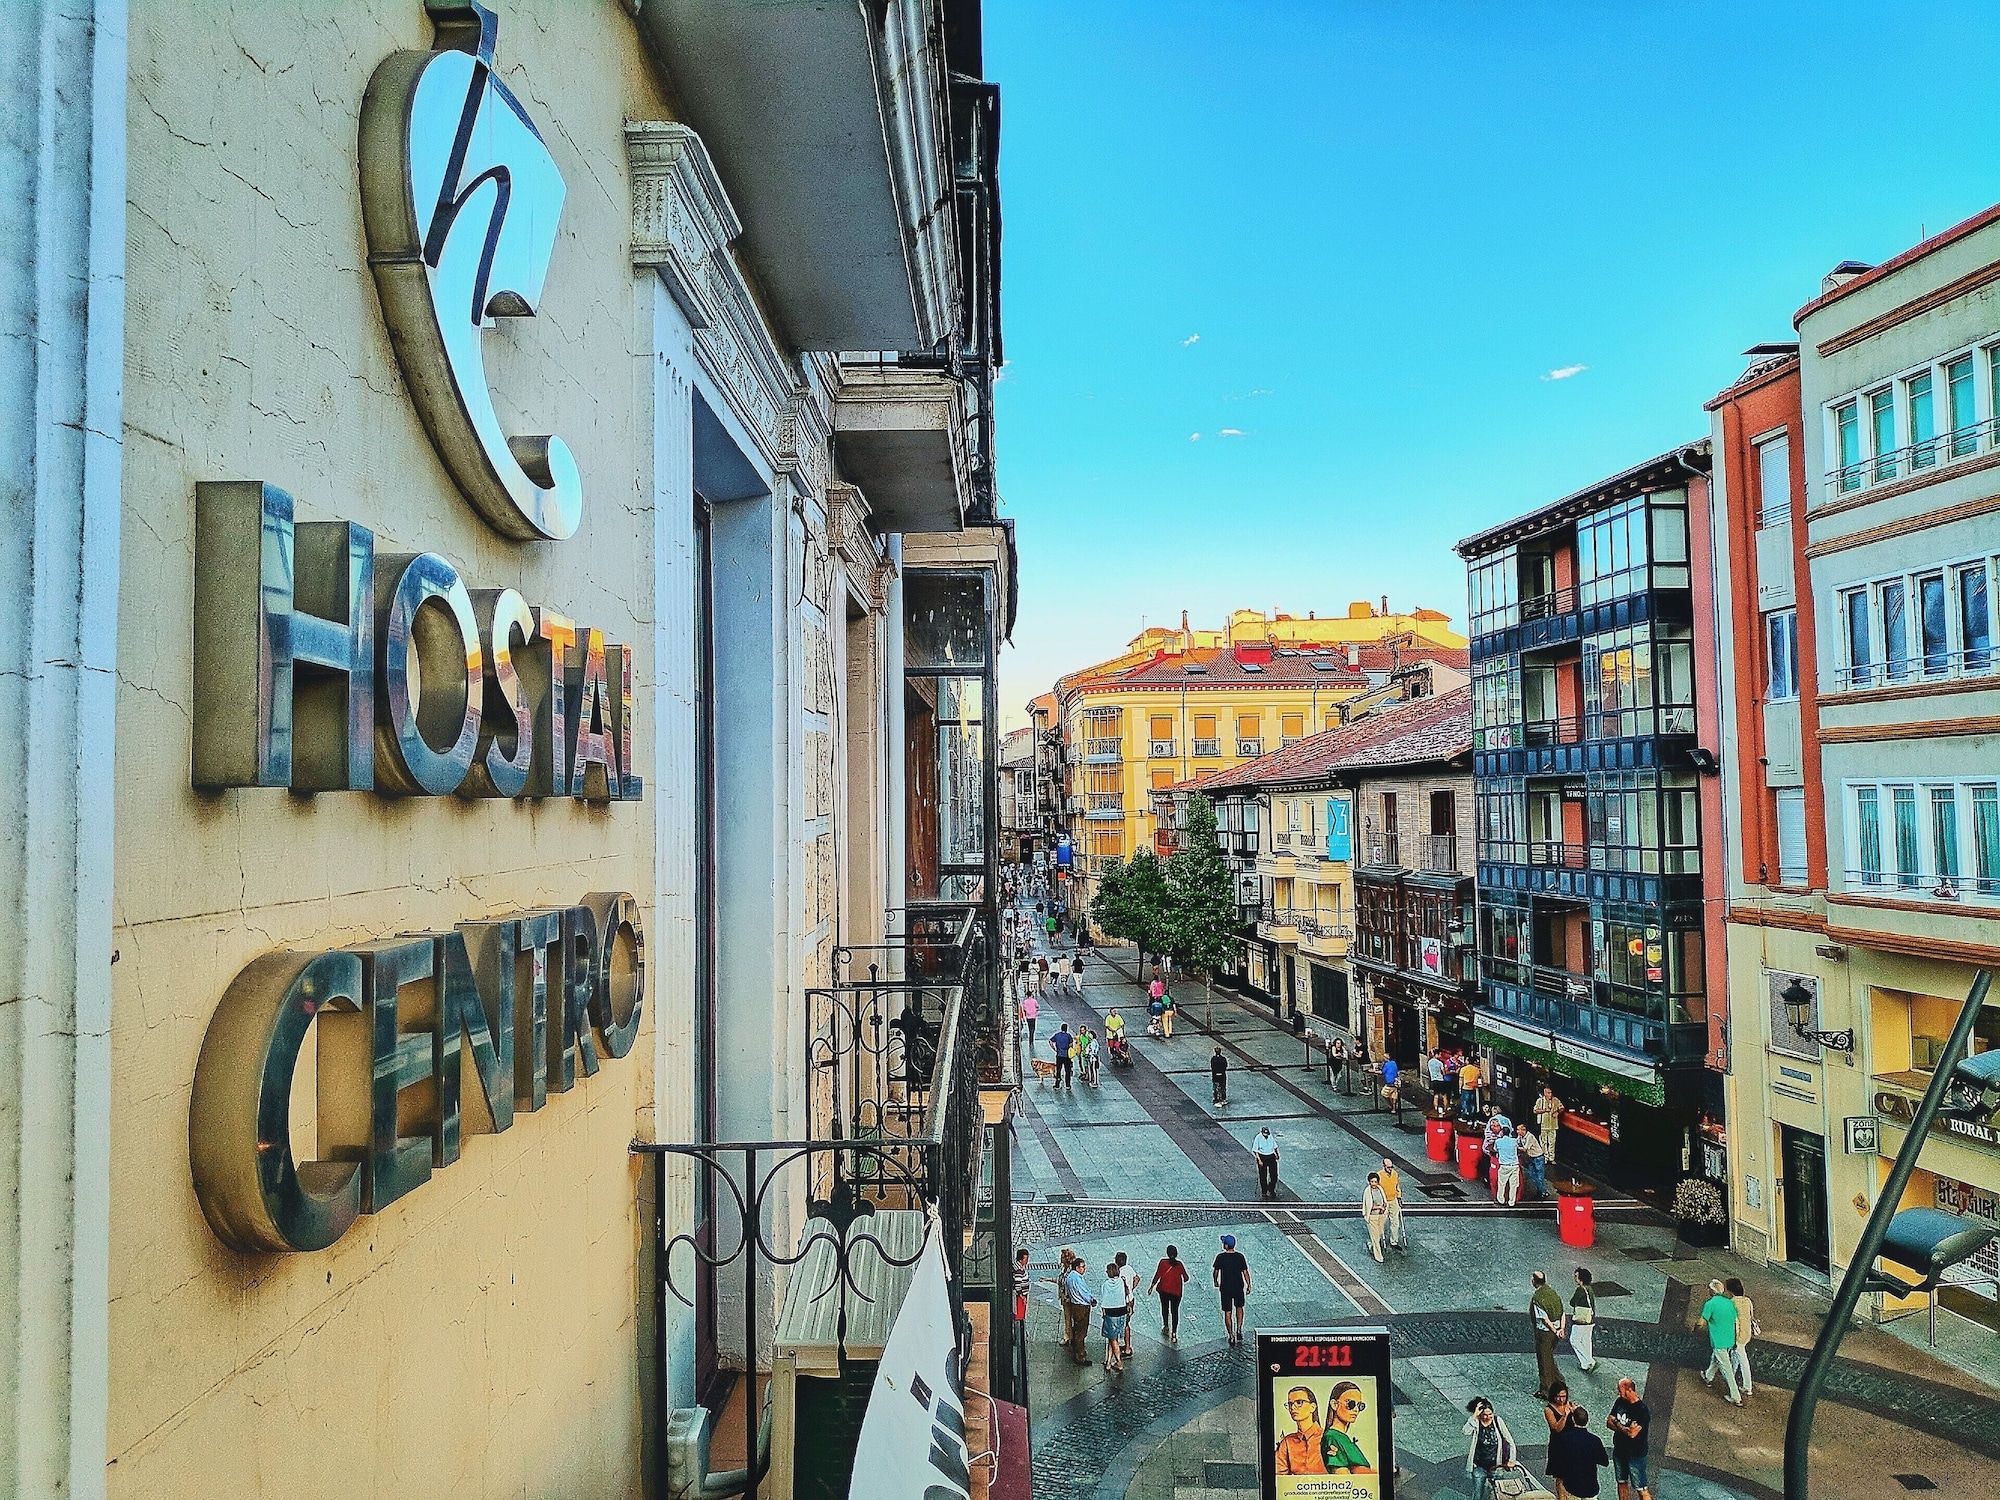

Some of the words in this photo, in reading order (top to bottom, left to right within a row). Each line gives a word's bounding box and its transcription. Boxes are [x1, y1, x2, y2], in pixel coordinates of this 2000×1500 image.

[193, 480, 643, 803] HOSTAL
[190, 891, 645, 1252] CENTRO
[1853, 1120, 1875, 1128] zona
[1949, 1118, 1993, 1142] RURAL
[1295, 1345, 1352, 1367] 21:11
[1297, 1481, 1352, 1490] combina2
[1352, 1488, 1373, 1499] 99€
